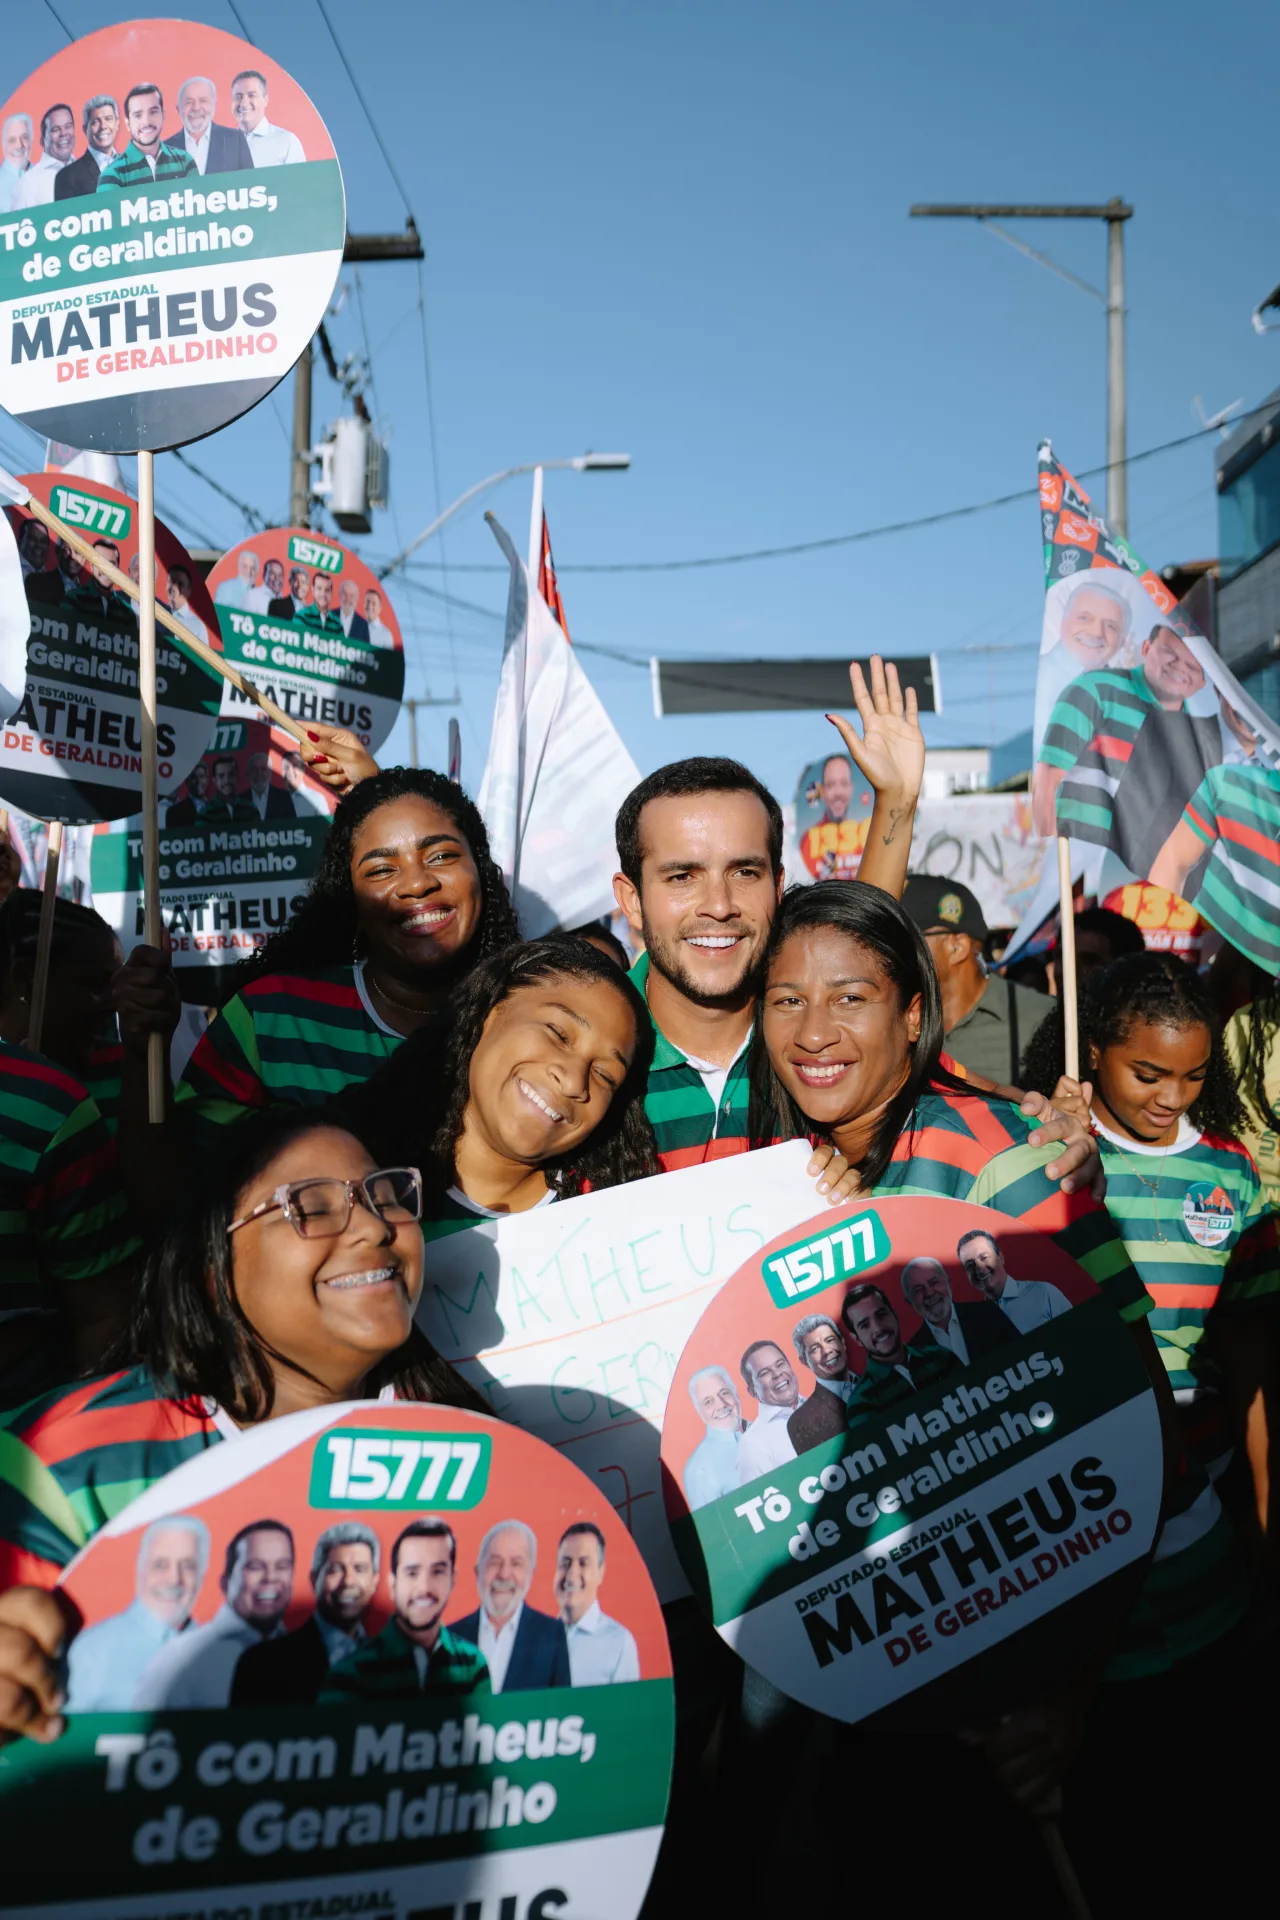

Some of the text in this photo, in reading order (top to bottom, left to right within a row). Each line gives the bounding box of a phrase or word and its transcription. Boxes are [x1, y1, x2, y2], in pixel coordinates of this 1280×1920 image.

[0, 185, 278, 251] Tô com Matheus,
[22, 222, 254, 282] de Geraldinho
[11, 282, 277, 365] MATHEUS
[12, 284, 158, 320] DEPUTADO ESTADUAL
[57, 332, 278, 383] DE GERALDINHO
[56, 489, 126, 537] 15777
[293, 538, 341, 571] 15777
[28, 641, 169, 694] Geraldino
[30, 615, 188, 675] om Mathus,
[229, 613, 379, 671] Tô com Matheus,
[242, 640, 367, 685] de Geraldinho
[7, 694, 176, 758] ATHEUS
[38, 686, 96, 707] ESTADUAL
[4, 732, 174, 779] DE GERALDINO
[127, 828, 312, 858] T com Matheus,
[159, 852, 297, 880] e Geraldinho
[170, 932, 270, 952] DE GERALD
[434, 1204, 766, 1347] MATHEUS
[768, 1218, 877, 1298] 15777
[327, 1437, 482, 1501] 15777
[734, 1351, 1064, 1534] Tô com Matheus,
[788, 1401, 1054, 1562] de Geraldinho
[795, 1508, 976, 1614] DEPUTADO ESTADUAL
[802, 1457, 1117, 1668] MATHEUS
[884, 1509, 1132, 1667] DE GERALDINHO
[95, 1712, 597, 1793] Tô com Matheus,
[133, 1778, 558, 1865] de Geraldinho
